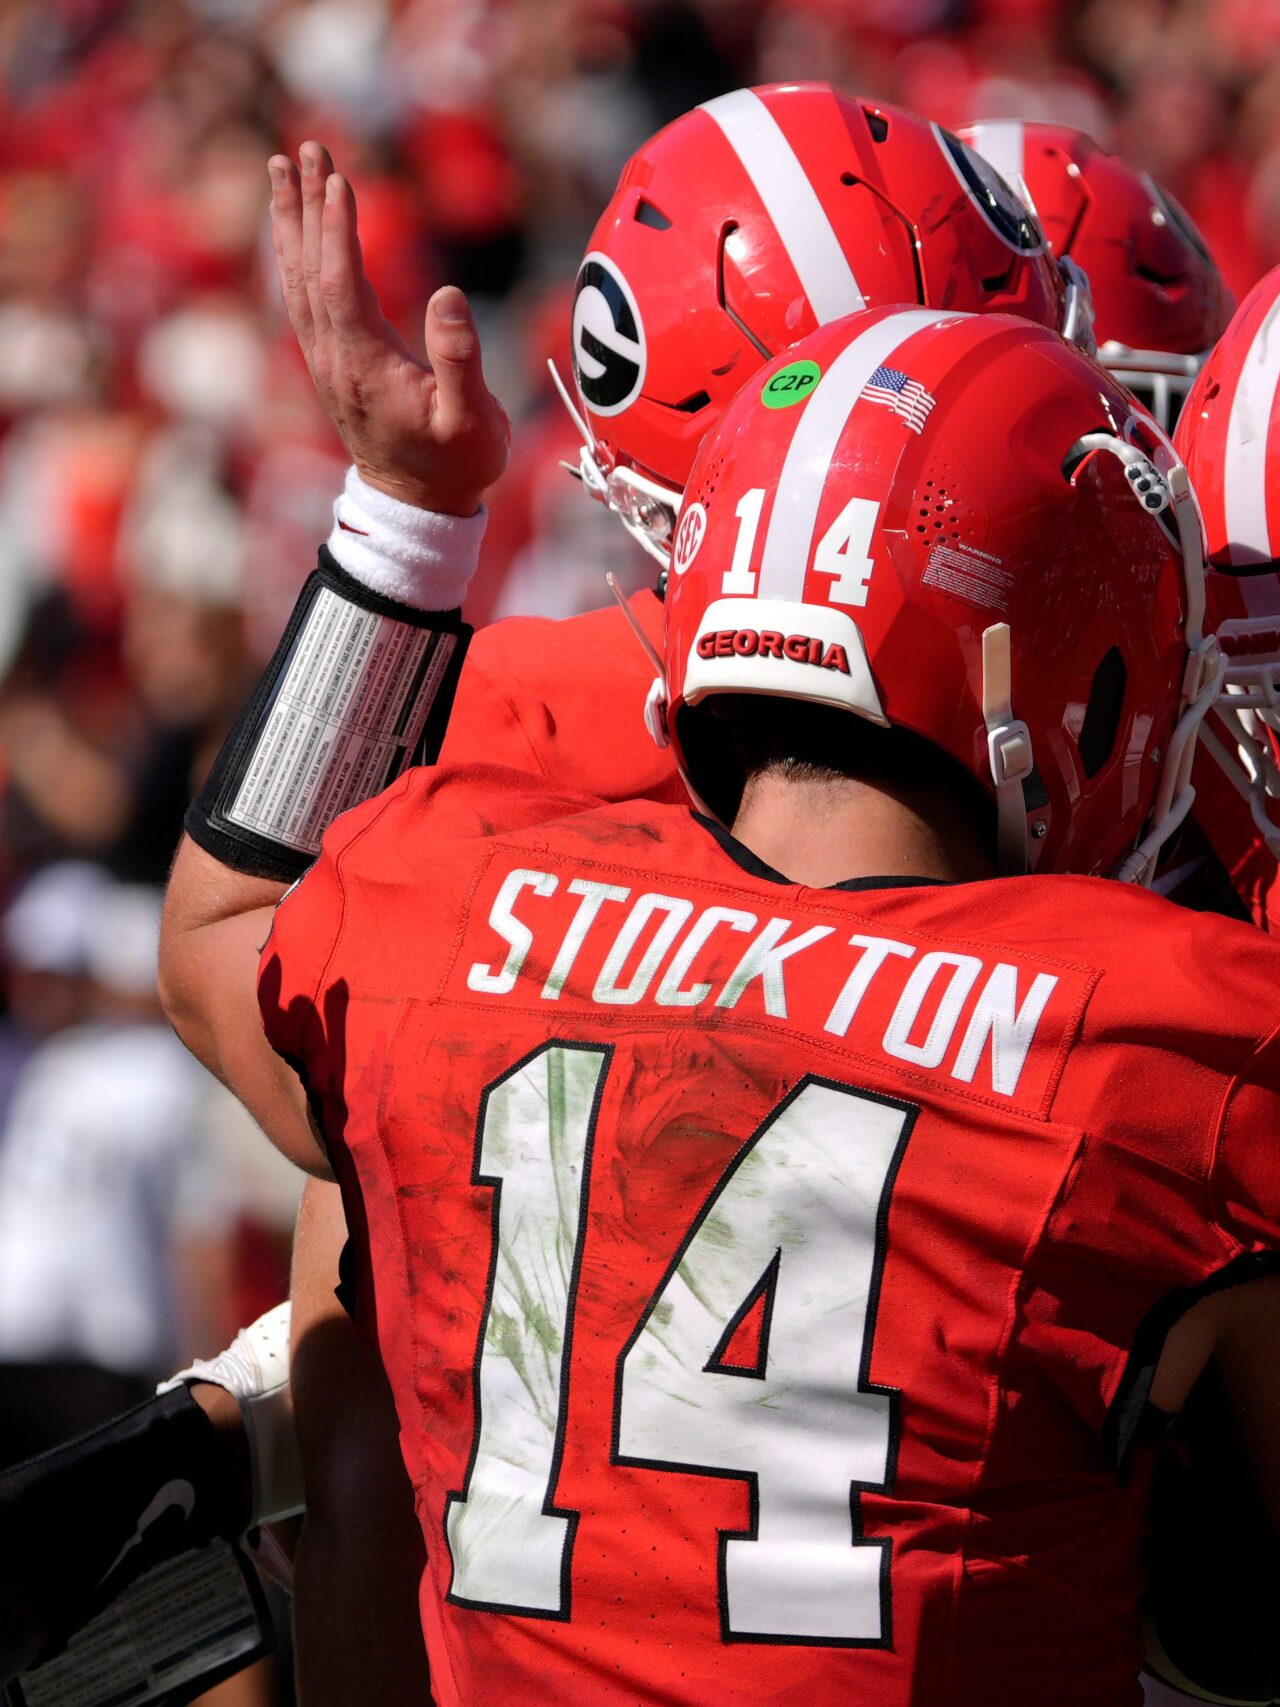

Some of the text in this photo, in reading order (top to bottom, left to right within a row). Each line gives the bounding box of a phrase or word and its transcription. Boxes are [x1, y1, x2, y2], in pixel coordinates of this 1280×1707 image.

[768, 371, 815, 395] C2P
[676, 506, 704, 570] SEC
[958, 543, 1003, 564] WARNING
[696, 628, 851, 674] GEORGIA
[467, 868, 1058, 1097] STOCKTON
[445, 1040, 919, 1650] 14
